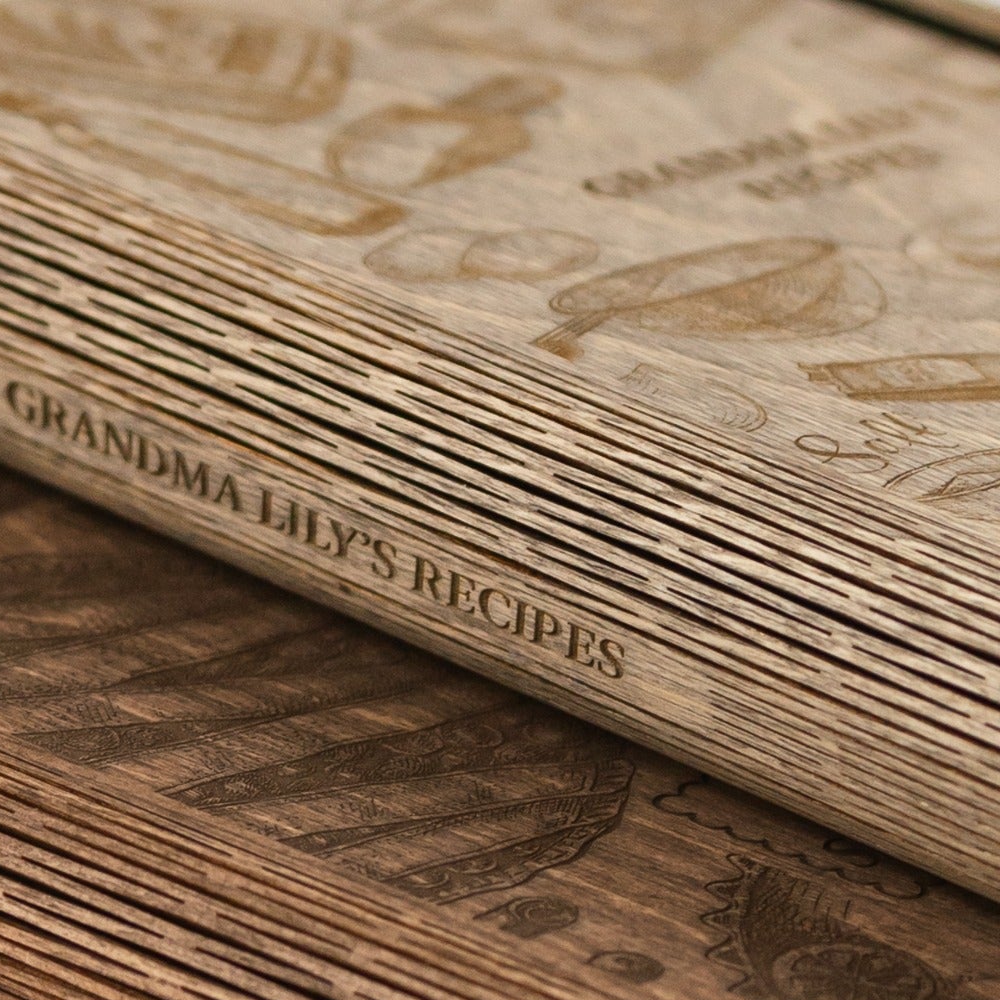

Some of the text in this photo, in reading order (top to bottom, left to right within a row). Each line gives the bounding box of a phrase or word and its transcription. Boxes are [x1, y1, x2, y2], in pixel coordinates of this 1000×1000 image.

[5, 381, 625, 679] GRANDMA LILY'S RECIPES
